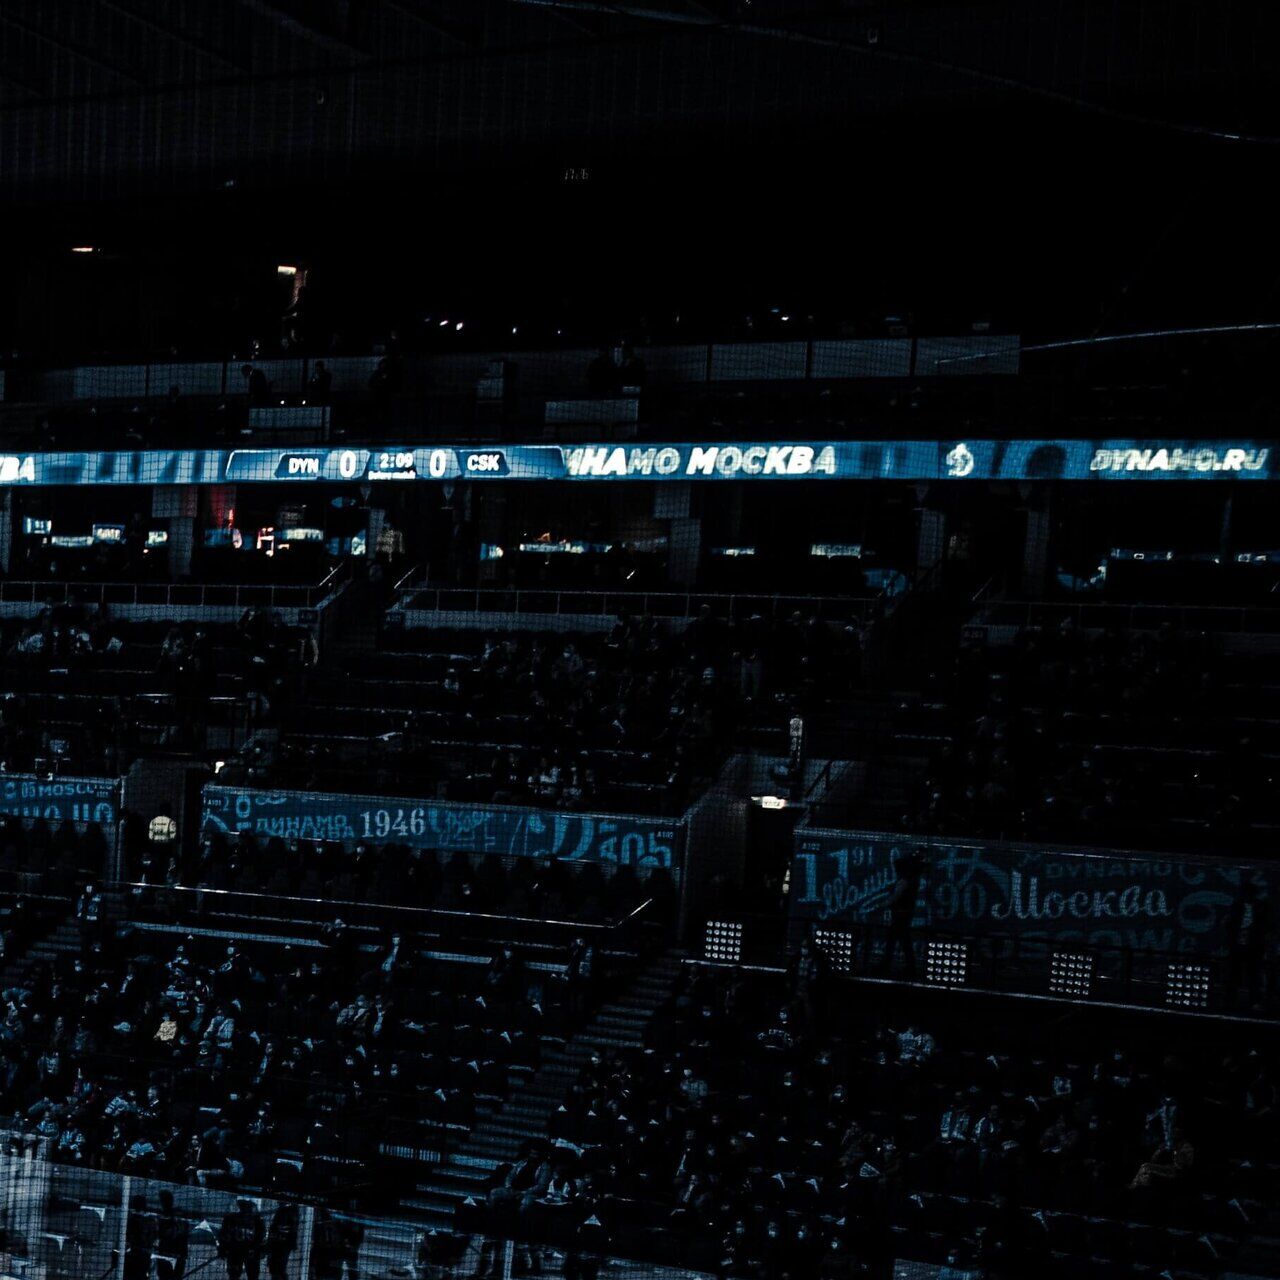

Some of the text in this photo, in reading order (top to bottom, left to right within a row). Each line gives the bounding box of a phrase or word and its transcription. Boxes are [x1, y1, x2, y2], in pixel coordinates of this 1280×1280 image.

[288, 458, 319, 473] DYN
[340, 451, 356, 477] 0
[380, 452, 413, 468] 2:09
[429, 450, 446, 477] 0
[467, 454, 499, 471] CSK
[686, 445, 837, 475] МОСКВА
[1090, 448, 1269, 471] DYNAMO.RU
[360, 808, 426, 838] 1946
[990, 867, 1176, 921] Москва
